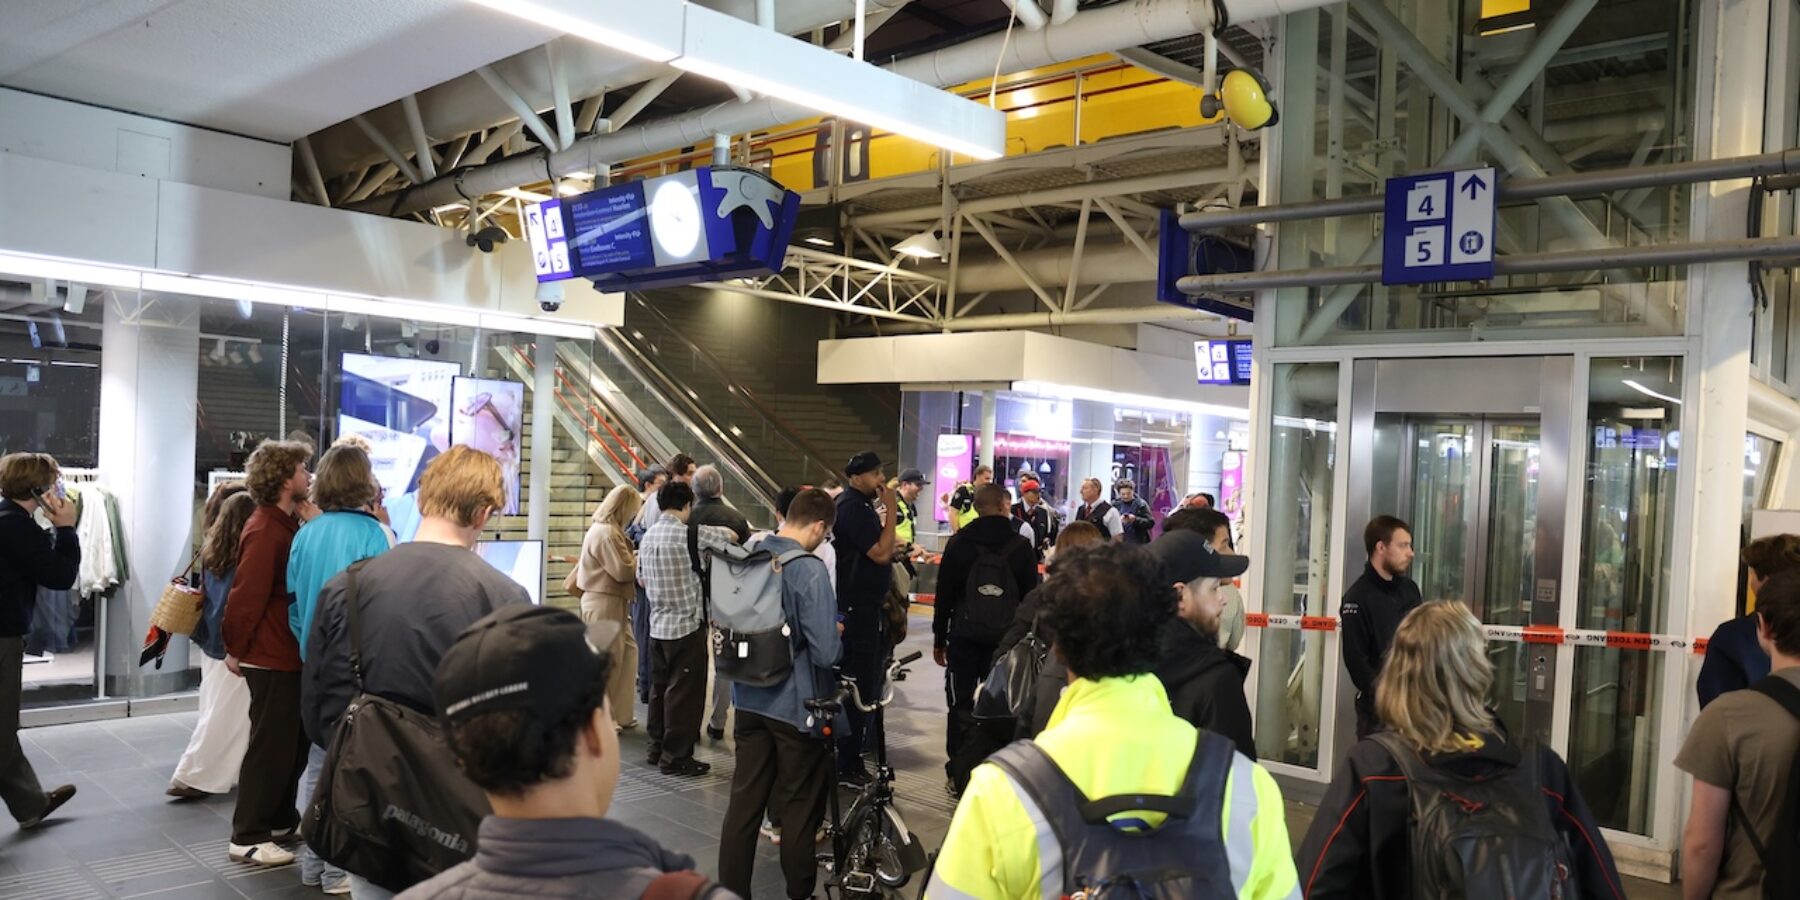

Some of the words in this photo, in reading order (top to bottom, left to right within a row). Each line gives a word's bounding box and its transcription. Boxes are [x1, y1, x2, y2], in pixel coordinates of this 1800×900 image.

[1418, 195, 1434, 216] 4
[550, 219, 558, 235] 4
[1416, 241, 1431, 263] 5
[556, 253, 564, 270] 5
[1586, 634, 1631, 645] TOEGANG
[1633, 636, 1660, 646] GEEN
[383, 804, 468, 854] patagonia
